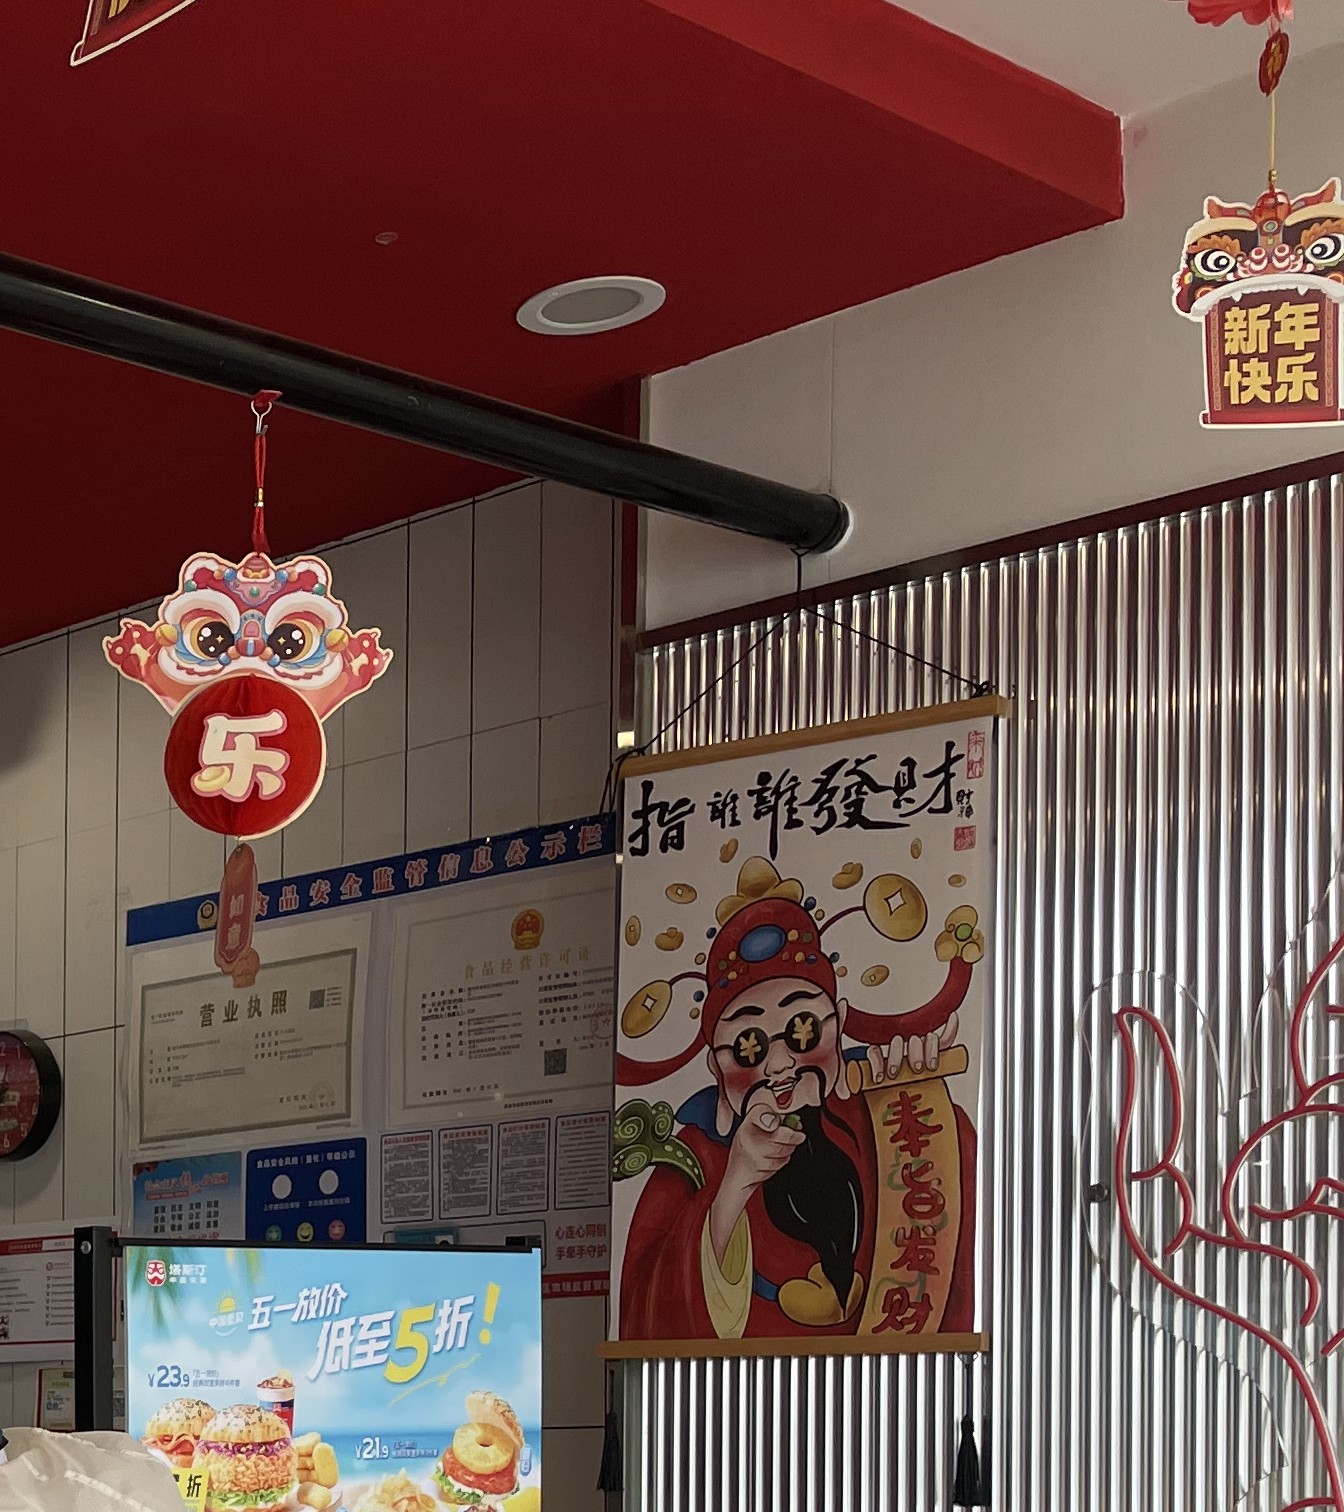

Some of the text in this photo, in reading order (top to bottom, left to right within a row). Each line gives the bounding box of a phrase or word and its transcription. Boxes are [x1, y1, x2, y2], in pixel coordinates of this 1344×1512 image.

[1224, 302, 1320, 356] 新年
[1223, 354, 1320, 405] 快乐
[192, 709, 289, 802] 乐
[199, 989, 289, 1028] 营业执照
[247, 1283, 348, 1333] 五一放价
[147, 1364, 191, 1389] ¥23.9
